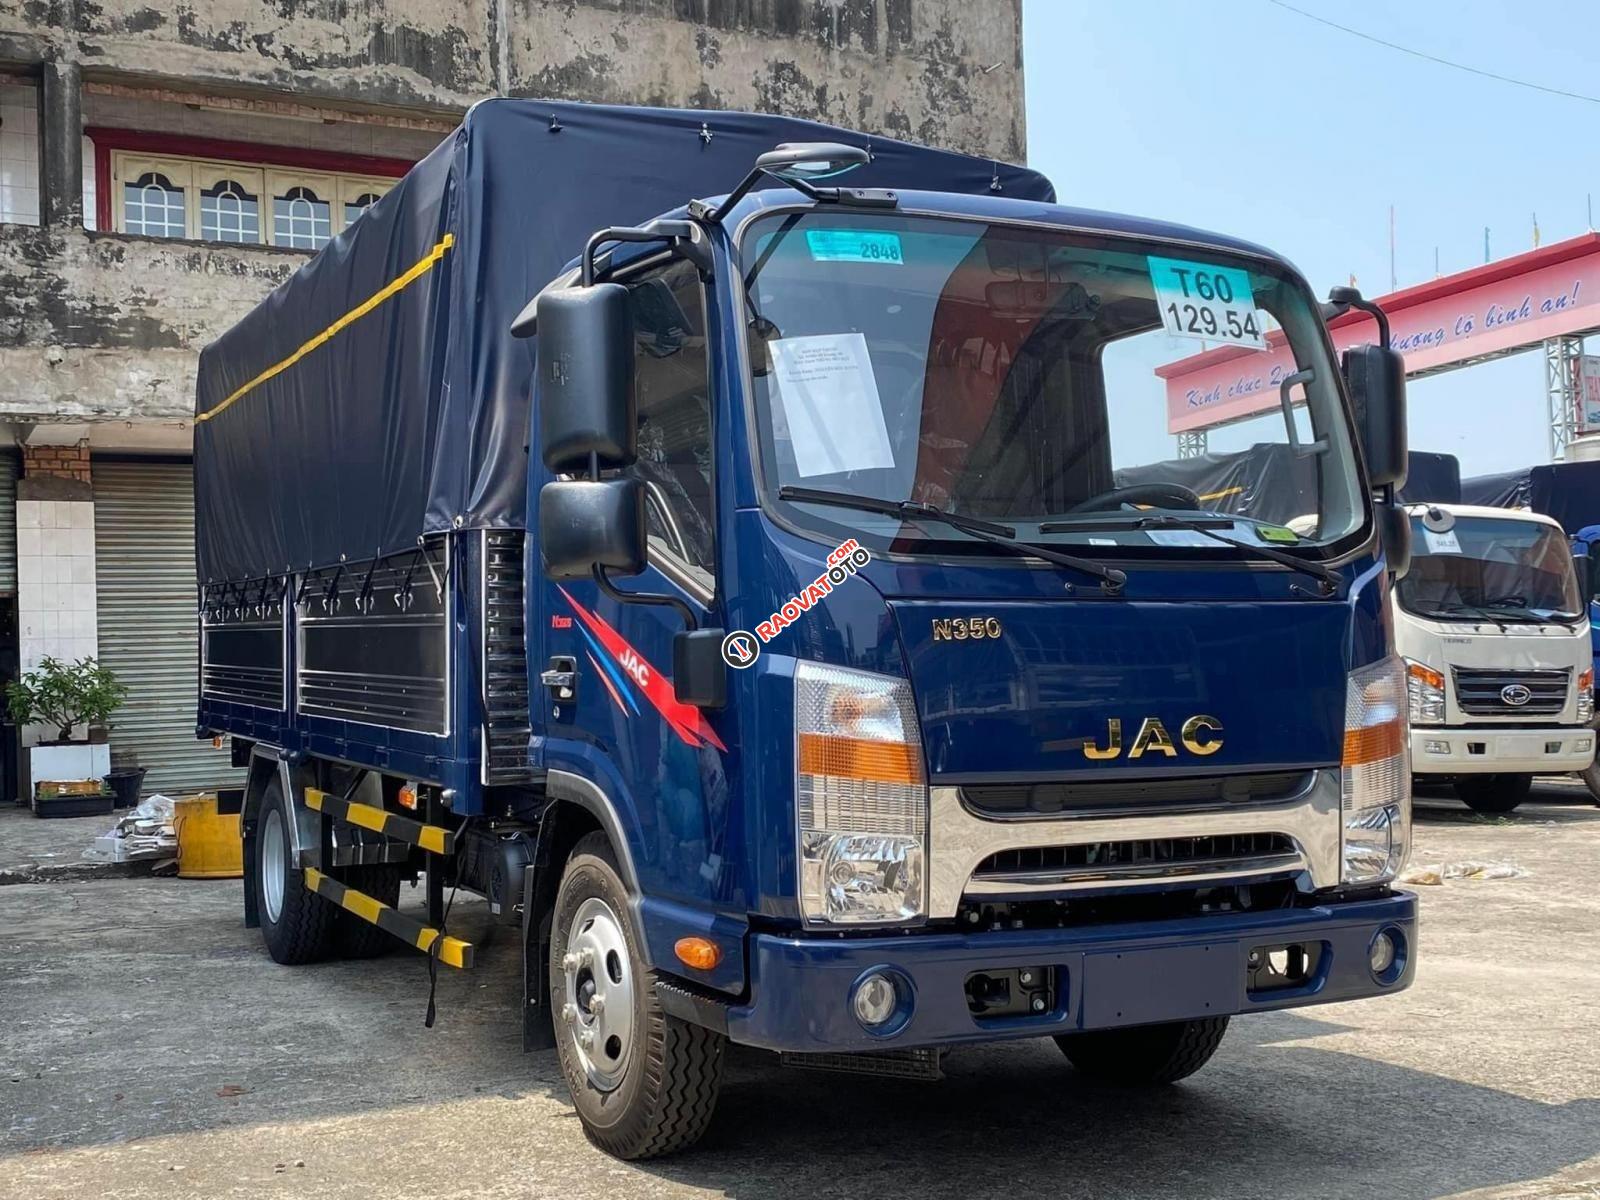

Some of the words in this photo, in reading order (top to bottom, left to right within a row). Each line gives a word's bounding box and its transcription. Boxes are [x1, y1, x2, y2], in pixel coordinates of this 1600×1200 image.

[861, 243, 899, 260] 2848
[1170, 267, 1233, 304] T60
[1541, 281, 1580, 312] an!
[1168, 302, 1260, 341] 129.54
[932, 617, 1002, 640] N350
[619, 648, 650, 687] JAC
[1083, 714, 1224, 759] JAC
